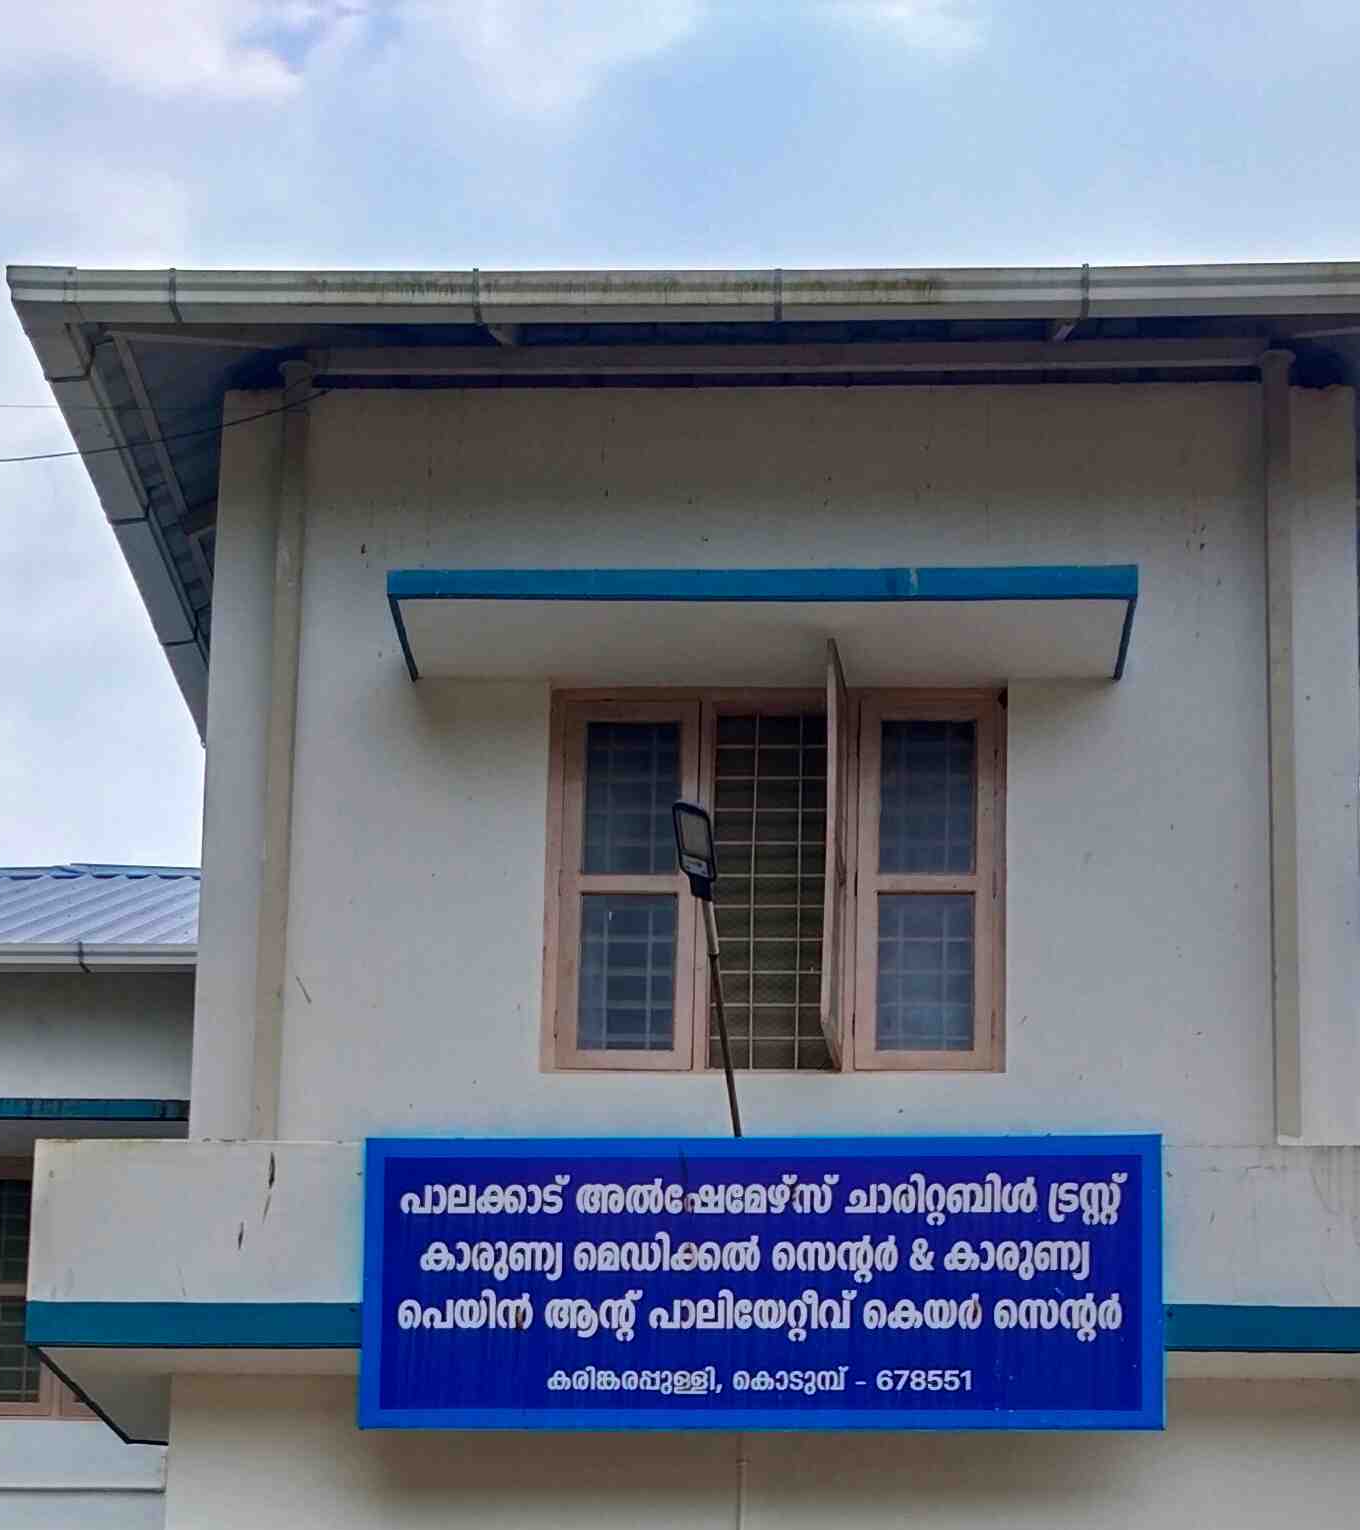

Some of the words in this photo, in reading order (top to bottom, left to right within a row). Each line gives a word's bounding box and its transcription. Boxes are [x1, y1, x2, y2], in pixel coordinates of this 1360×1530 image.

[400, 1174, 570, 1215] പാലക്കാട്
[844, 1172, 1038, 1226] ചാരിറ്റബിൾ
[1048, 1172, 1128, 1225] ട്രസ്റ്റ്
[420, 1240, 563, 1281] കാരുണ്യ
[573, 1231, 761, 1272] മെഡിക്കൽ
[772, 1235, 899, 1283] സെന്റർ
[909, 1237, 935, 1272] &
[943, 1240, 1090, 1281] കാരുണ്യ
[397, 1289, 534, 1330] പെയിൻ
[544, 1289, 643, 1342] ആന്റ്
[648, 1288, 858, 1342] പാലിയേറ്റീവ്
[863, 1293, 982, 1330] കെയർ
[993, 1292, 1123, 1342] സെന്റർ
[732, 1366, 849, 1395] കൊടുമ്പ്
[876, 1369, 973, 1392] 678551
